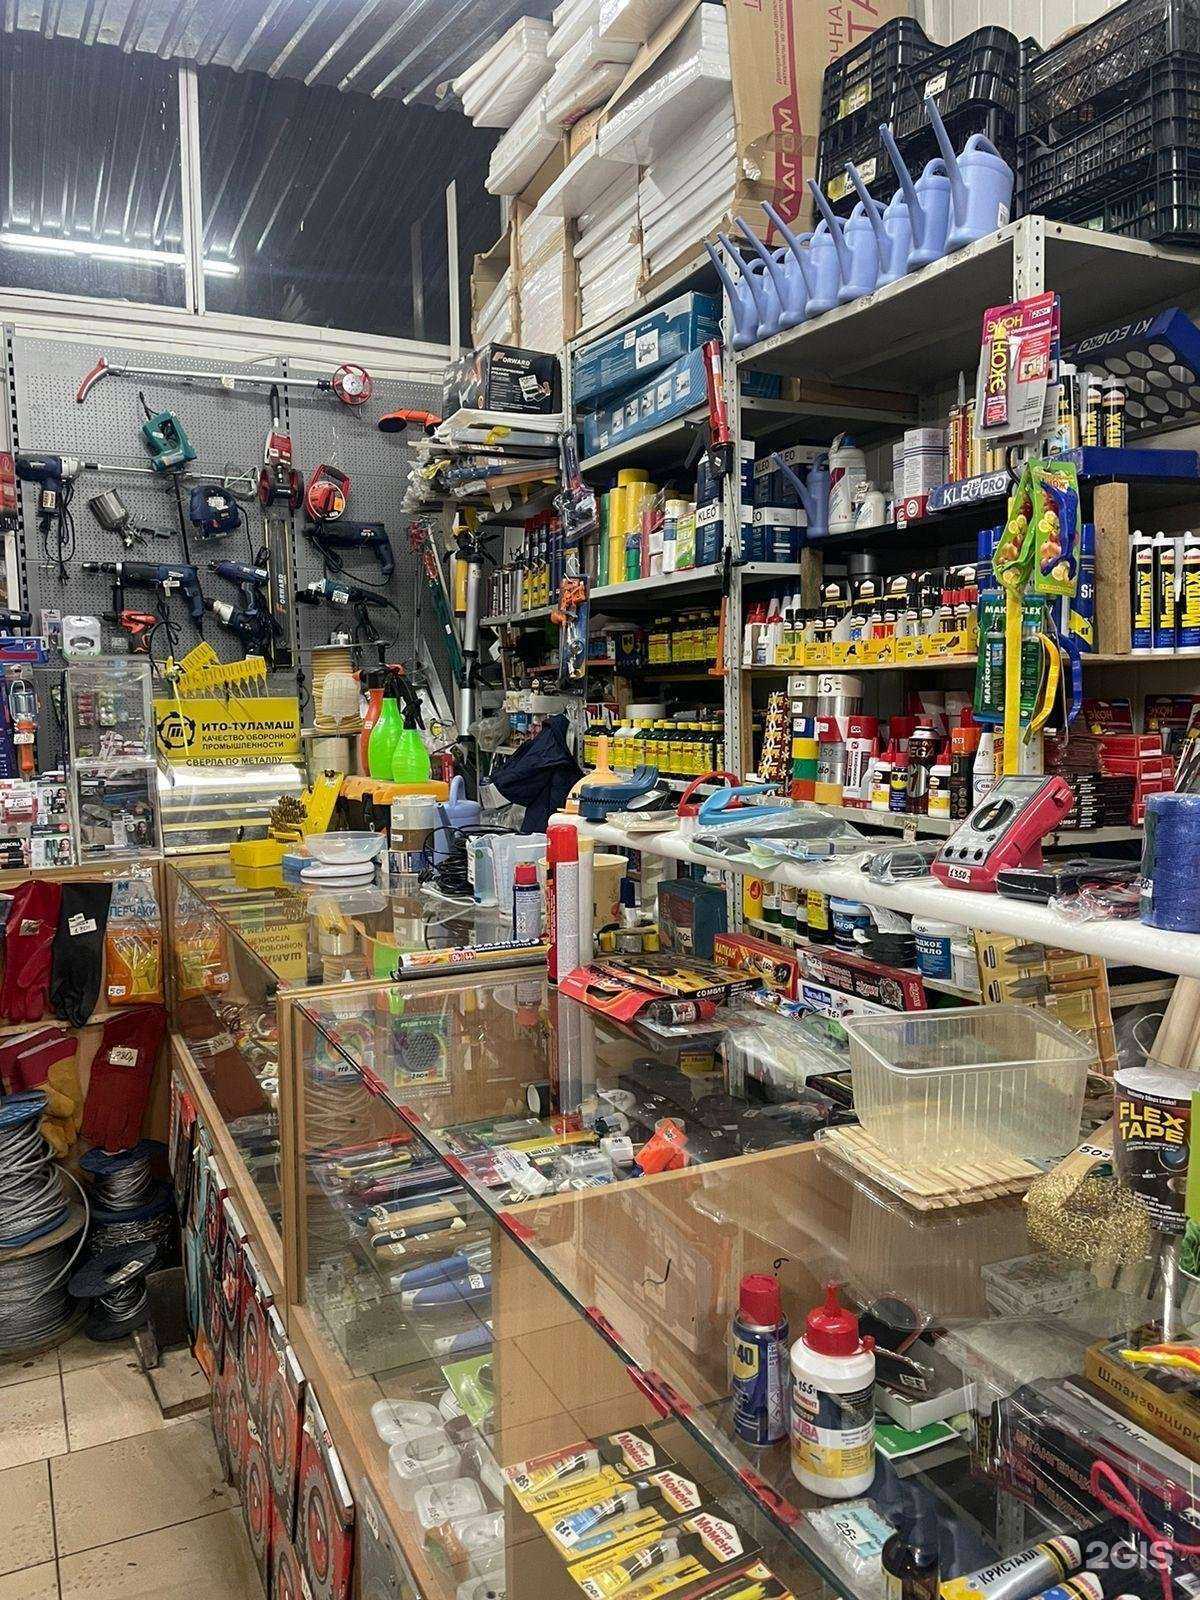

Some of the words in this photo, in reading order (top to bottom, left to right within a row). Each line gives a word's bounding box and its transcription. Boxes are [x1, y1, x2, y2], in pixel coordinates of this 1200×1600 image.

[984, 605, 1042, 616] MAKFLEX
[984, 643, 992, 704] MAKROFLEX
[201, 721, 295, 732] ИТО-ТУЛАМАШ
[202, 734, 245, 743] КАЧЕСТВО
[246, 732, 297, 741] ОБОРОННОЙ
[202, 742, 284, 751] ПРОМЫШЛЕННОСТИ
[185, 758, 223, 767] СВЕРЛА
[225, 757, 239, 766] ПО
[241, 756, 283, 766] МЕТАЛЛУ
[1118, 1101, 1186, 1132] FLEX
[1119, 1121, 1185, 1145] TAPE
[657, 1471, 694, 1511] Момент
[694, 1513, 738, 1557] Момент
[714, 1521, 735, 1541] Супер
[978, 1549, 1041, 1585] КРИСТАЛЛ
